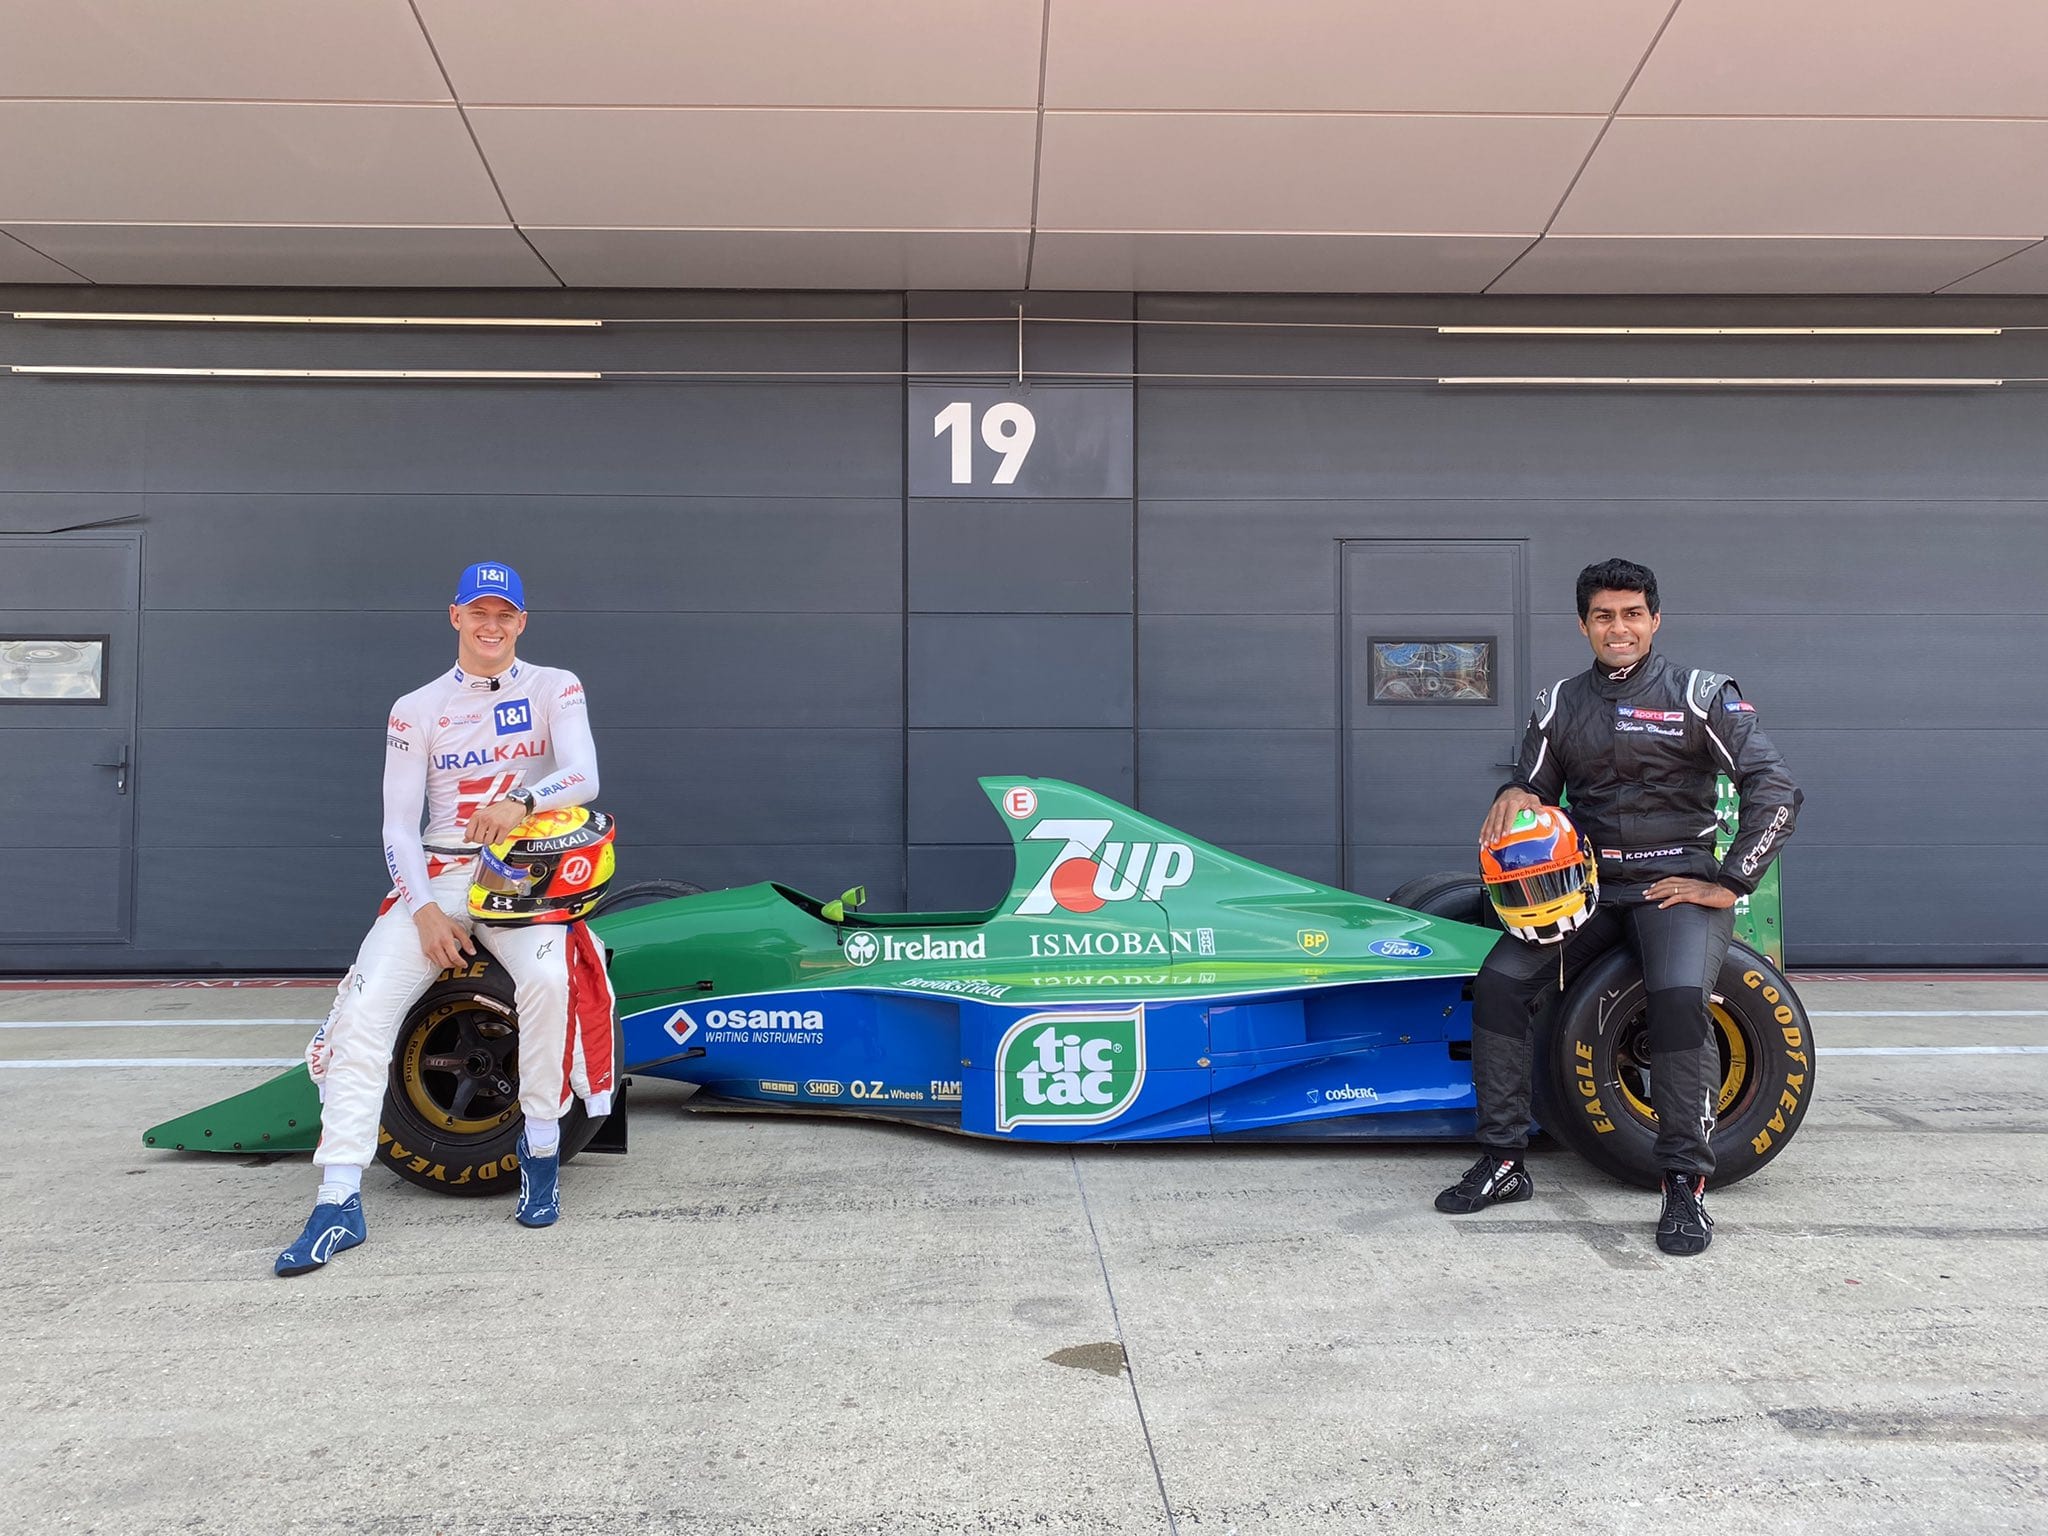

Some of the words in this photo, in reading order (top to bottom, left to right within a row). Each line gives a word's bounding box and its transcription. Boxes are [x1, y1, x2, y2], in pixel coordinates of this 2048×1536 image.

[934, 402, 1036, 484] 19
[481, 569, 504, 582] 1&1
[497, 706, 528, 727] 1&1
[433, 740, 546, 769] URALKALI
[536, 773, 586, 797] URALKALI
[1012, 793, 1028, 812] E
[527, 832, 589, 852] URALKALI
[386, 845, 413, 904] URALKALI
[1012, 818, 1195, 915] 7UP
[883, 933, 986, 960] Ireland
[1029, 931, 1193, 957] ISMOBAN
[1304, 934, 1325, 947] BP
[1381, 942, 1420, 956] Ford
[706, 1009, 824, 1030] osama
[312, 1014, 331, 1075] ALKALI
[706, 1031, 749, 1044] WRITING
[752, 1032, 824, 1045] INSTRUMENTS
[1034, 1027, 1113, 1072] tic
[406, 1041, 419, 1082] Racing
[1743, 970, 1807, 1155] GOODYEAR
[809, 1082, 839, 1095] SHOEI
[850, 1080, 889, 1099] O.Z.
[890, 1089, 924, 1101] Wheels
[931, 1081, 962, 1094] FIAM
[1017, 1061, 1113, 1105] tac
[1576, 1040, 1616, 1134] EAGLE
